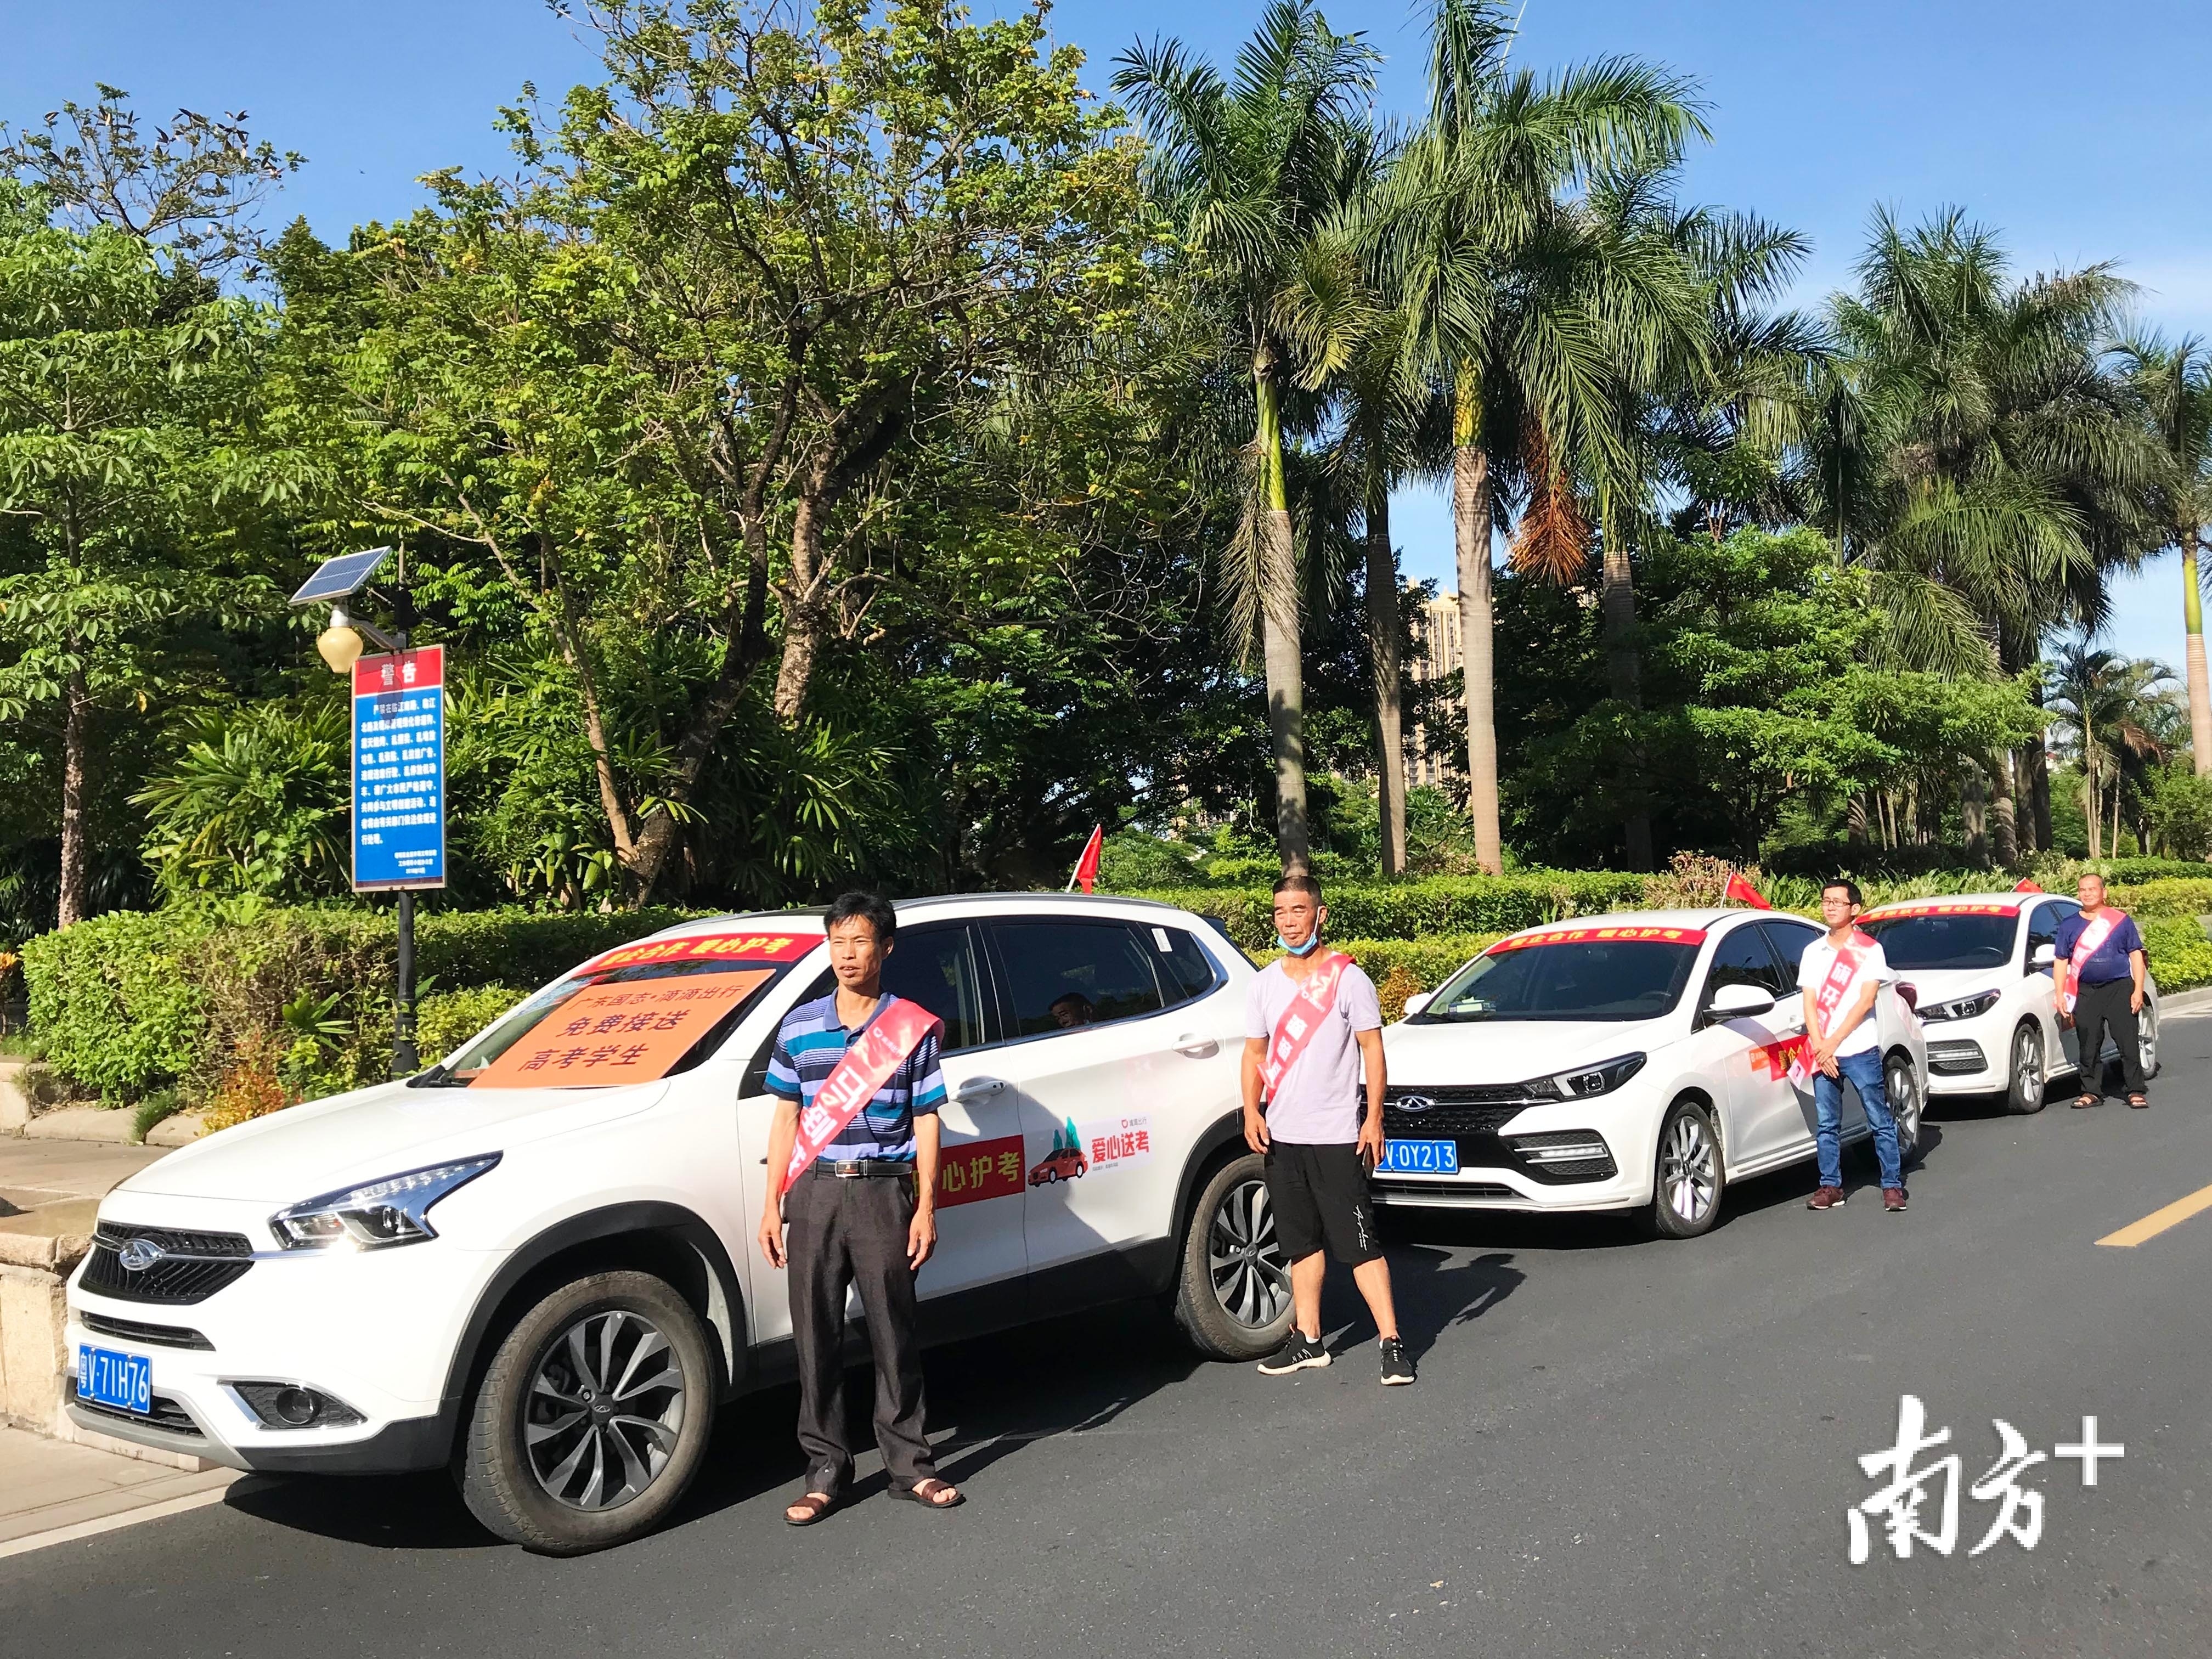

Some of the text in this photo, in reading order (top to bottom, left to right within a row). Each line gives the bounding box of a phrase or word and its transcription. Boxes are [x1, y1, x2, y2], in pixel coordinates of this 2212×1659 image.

[381, 661, 417, 685] 警告
[689, 936, 794, 955] 暖心护考
[1596, 928, 1683, 939] 暖心护考
[555, 1009, 691, 1038] 免费接送
[517, 1043, 650, 1072] 高考学生
[1092, 1130, 1149, 1164] 爱心送考
[1380, 1144, 1454, 1167] V·0Y213
